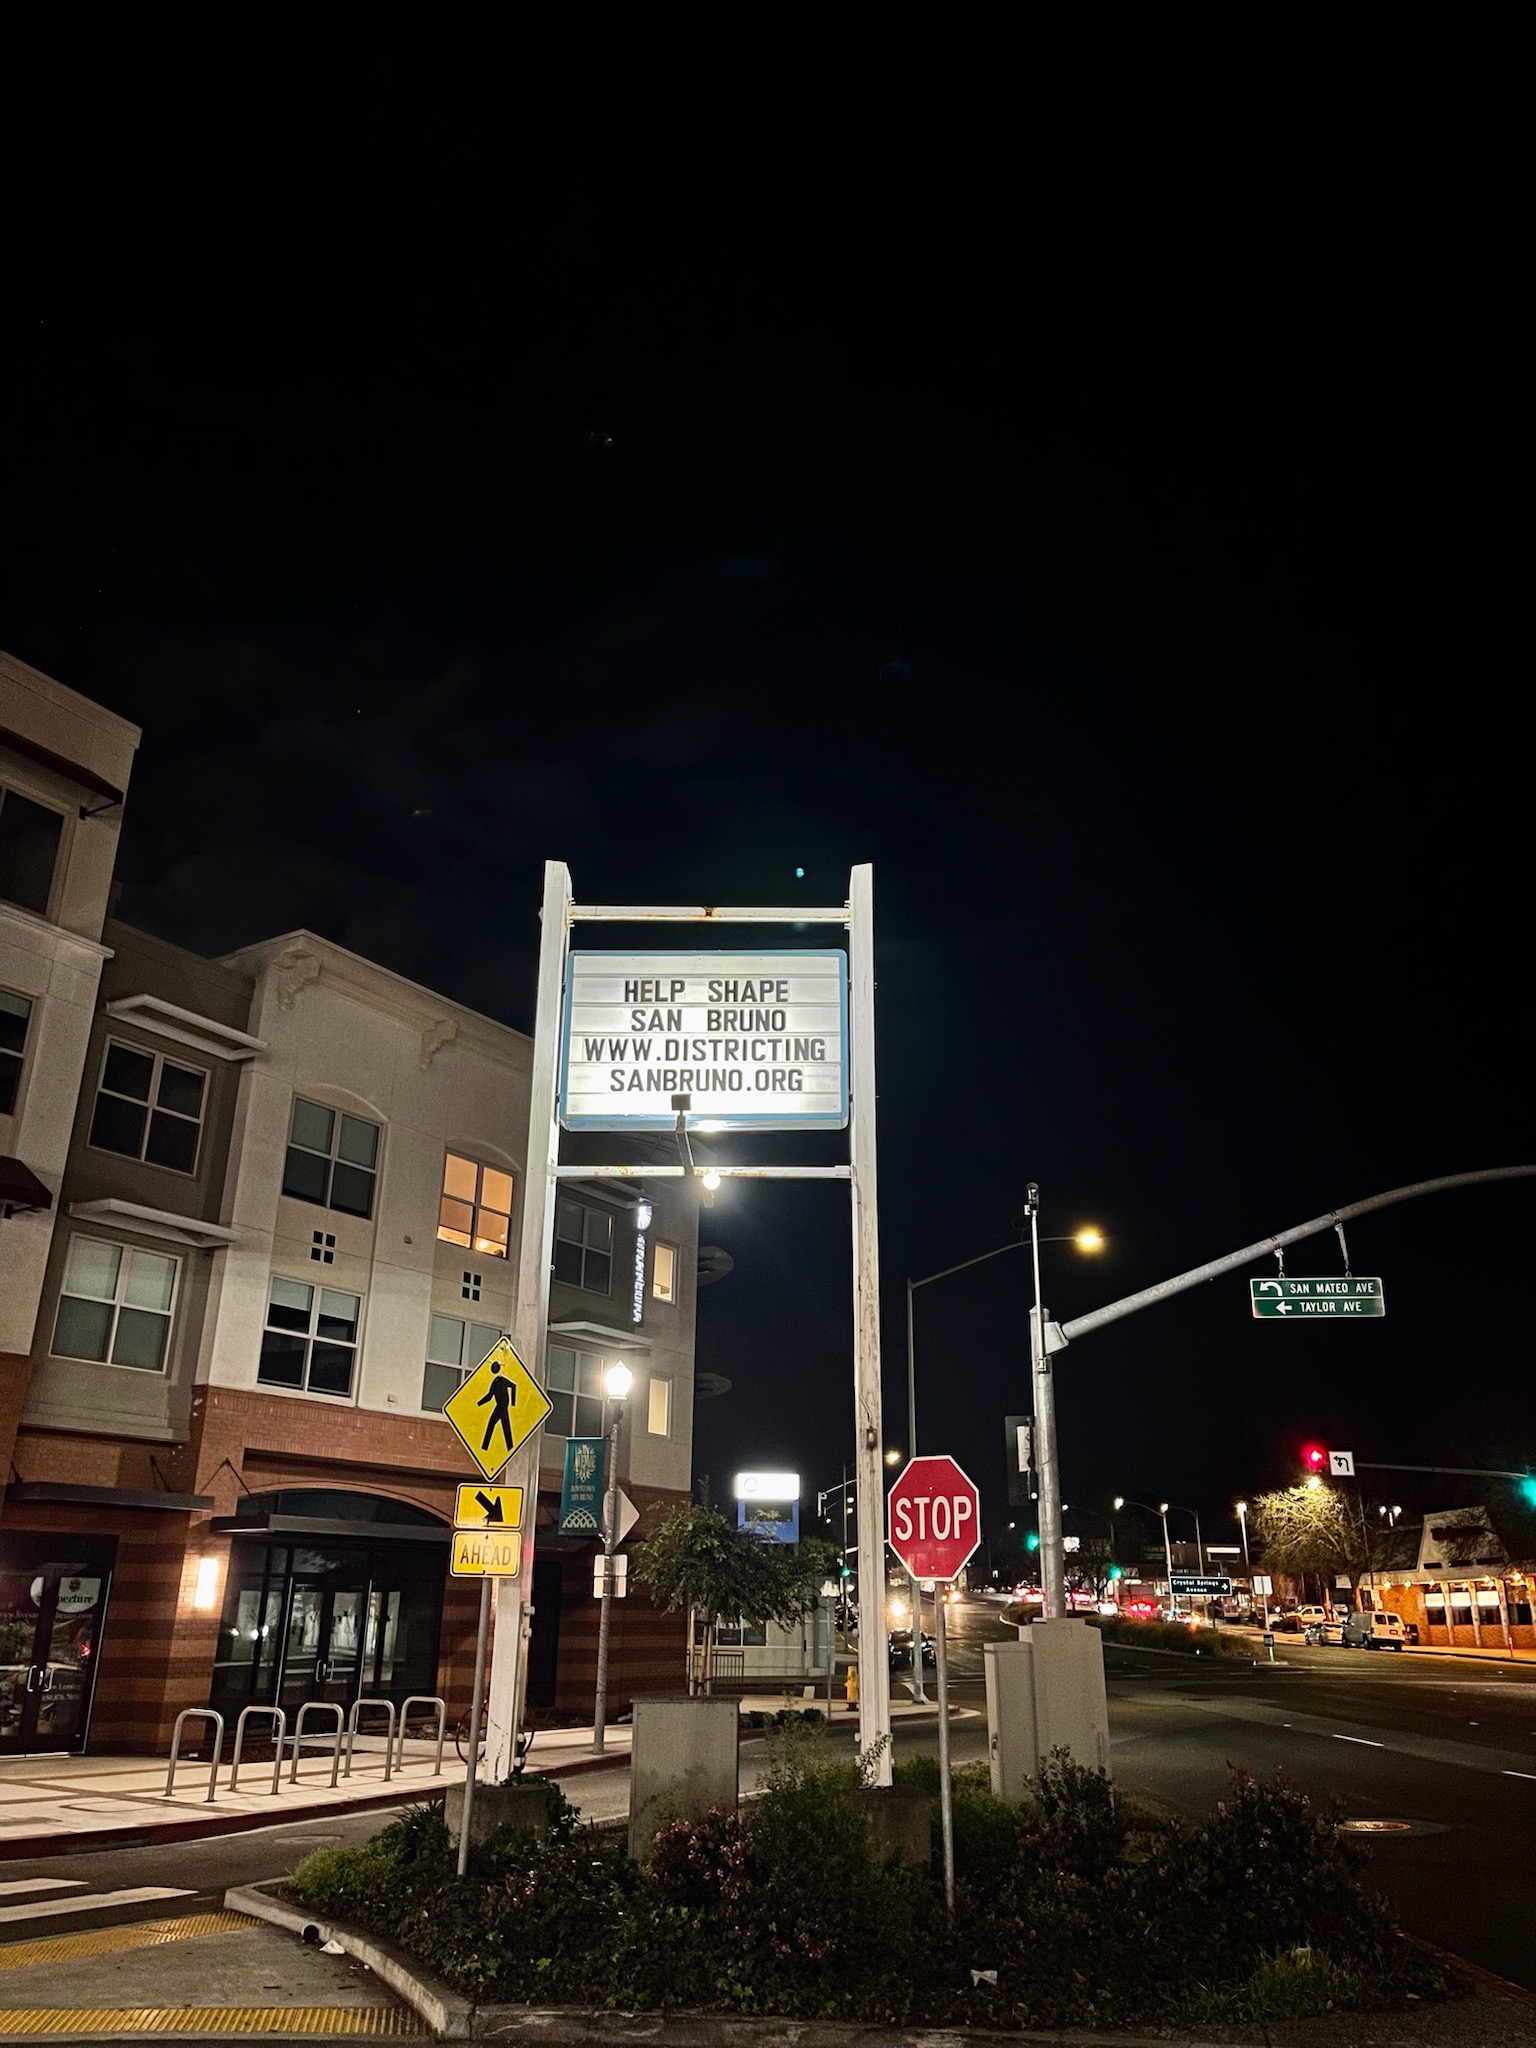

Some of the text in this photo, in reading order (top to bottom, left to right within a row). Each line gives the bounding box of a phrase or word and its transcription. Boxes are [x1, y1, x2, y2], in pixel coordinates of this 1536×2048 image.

[624, 980, 789, 1002] HELP SHAPE
[631, 1009, 786, 1032] SAN BRUNO
[584, 1038, 826, 1061] WWW.DISTRICTING
[610, 1068, 803, 1092] SANBRUNO.ORG
[1290, 1282, 1374, 1294] SAN MATEO AVE
[1299, 1301, 1362, 1312] TAYLOR AVE
[895, 1495, 972, 1541] STOP
[460, 1543, 512, 1566] AHEAD
